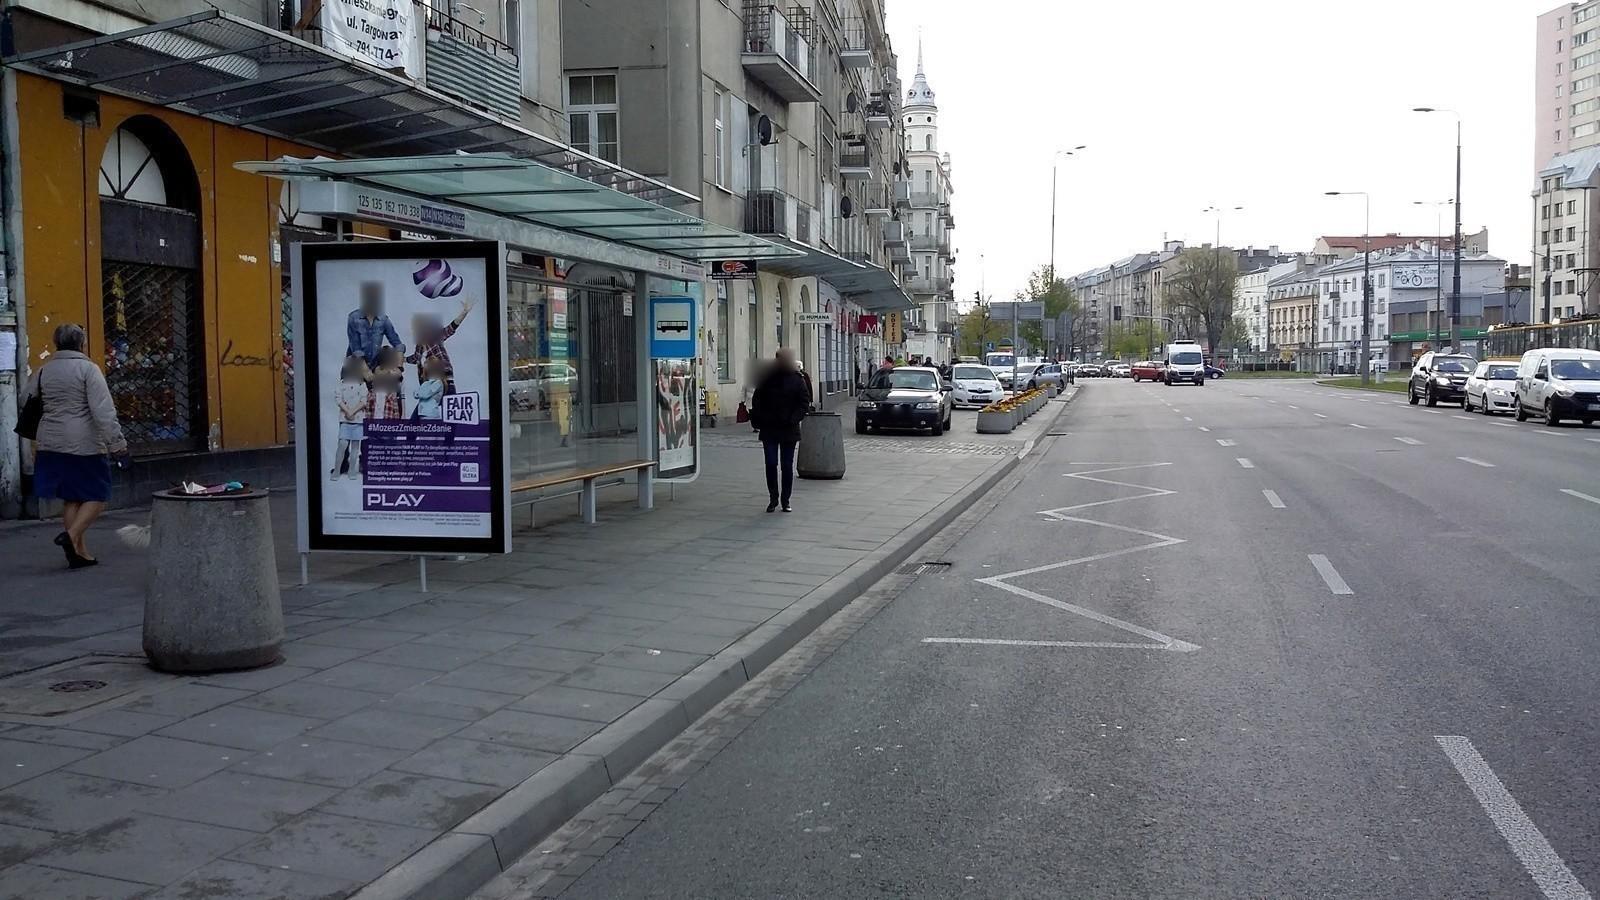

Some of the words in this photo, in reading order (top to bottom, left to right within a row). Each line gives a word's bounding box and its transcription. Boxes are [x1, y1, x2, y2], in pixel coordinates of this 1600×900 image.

[347, 16, 358, 29] ul.
[358, 195, 369, 208] 125
[372, 198, 382, 210] 135
[385, 200, 395, 212] 162
[398, 203, 408, 216] 170
[447, 397, 473, 409] FAIR
[447, 410, 474, 421] PLAY
[368, 494, 425, 506] PLAY
